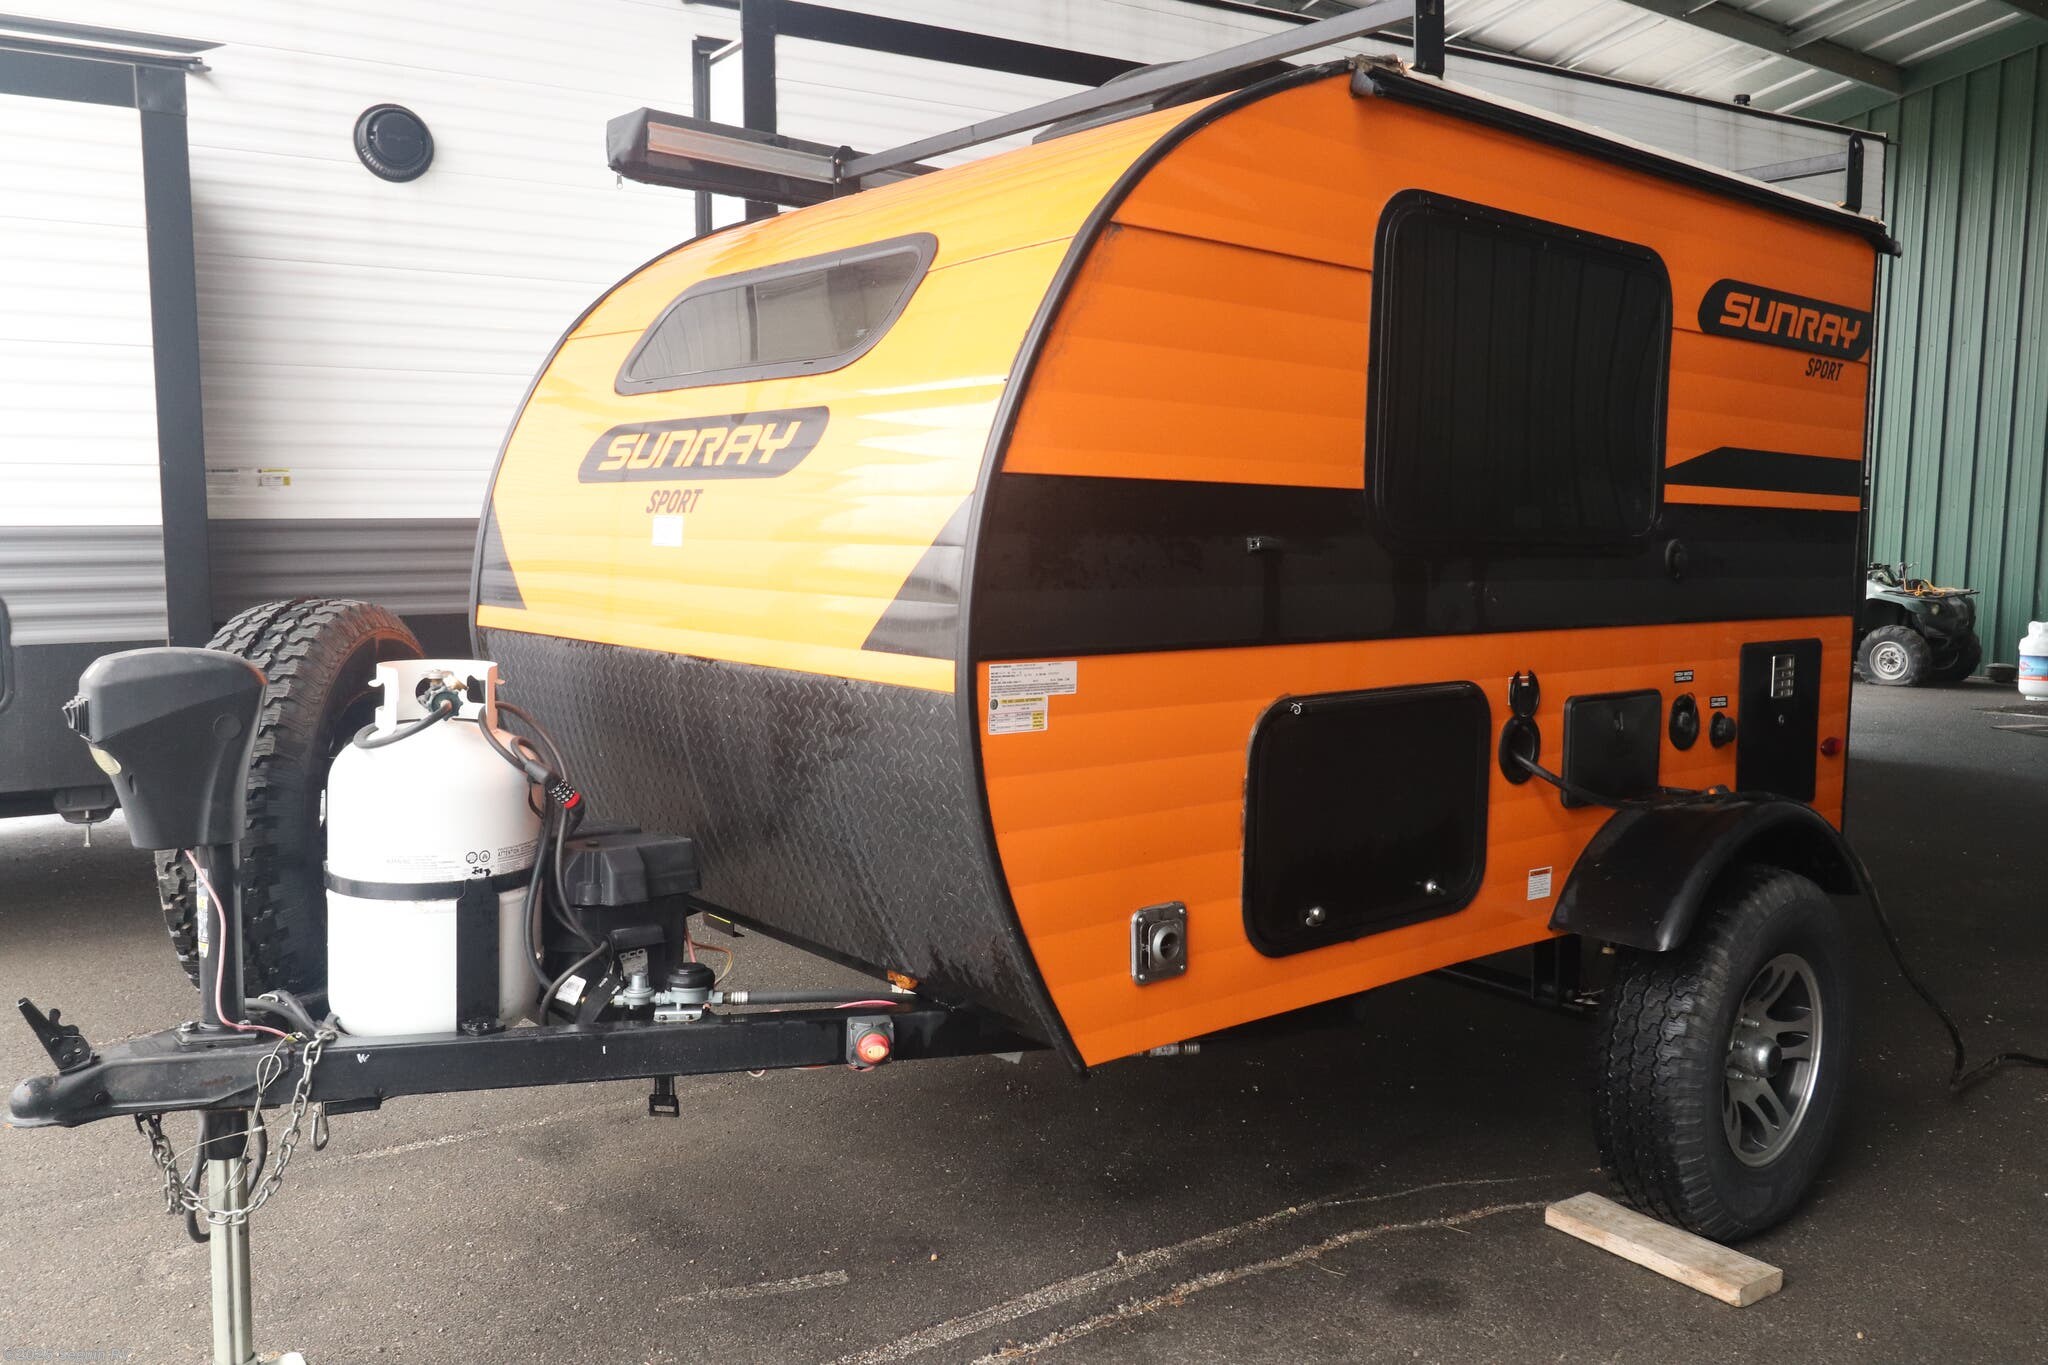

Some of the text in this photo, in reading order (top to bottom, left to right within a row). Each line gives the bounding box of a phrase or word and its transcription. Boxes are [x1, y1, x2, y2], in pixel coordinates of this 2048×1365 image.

[1720, 292, 1862, 349] SUNRAY
[1806, 358, 1843, 381] SPORT
[598, 421, 802, 471] SUNRAY
[646, 489, 704, 514] SPORT
